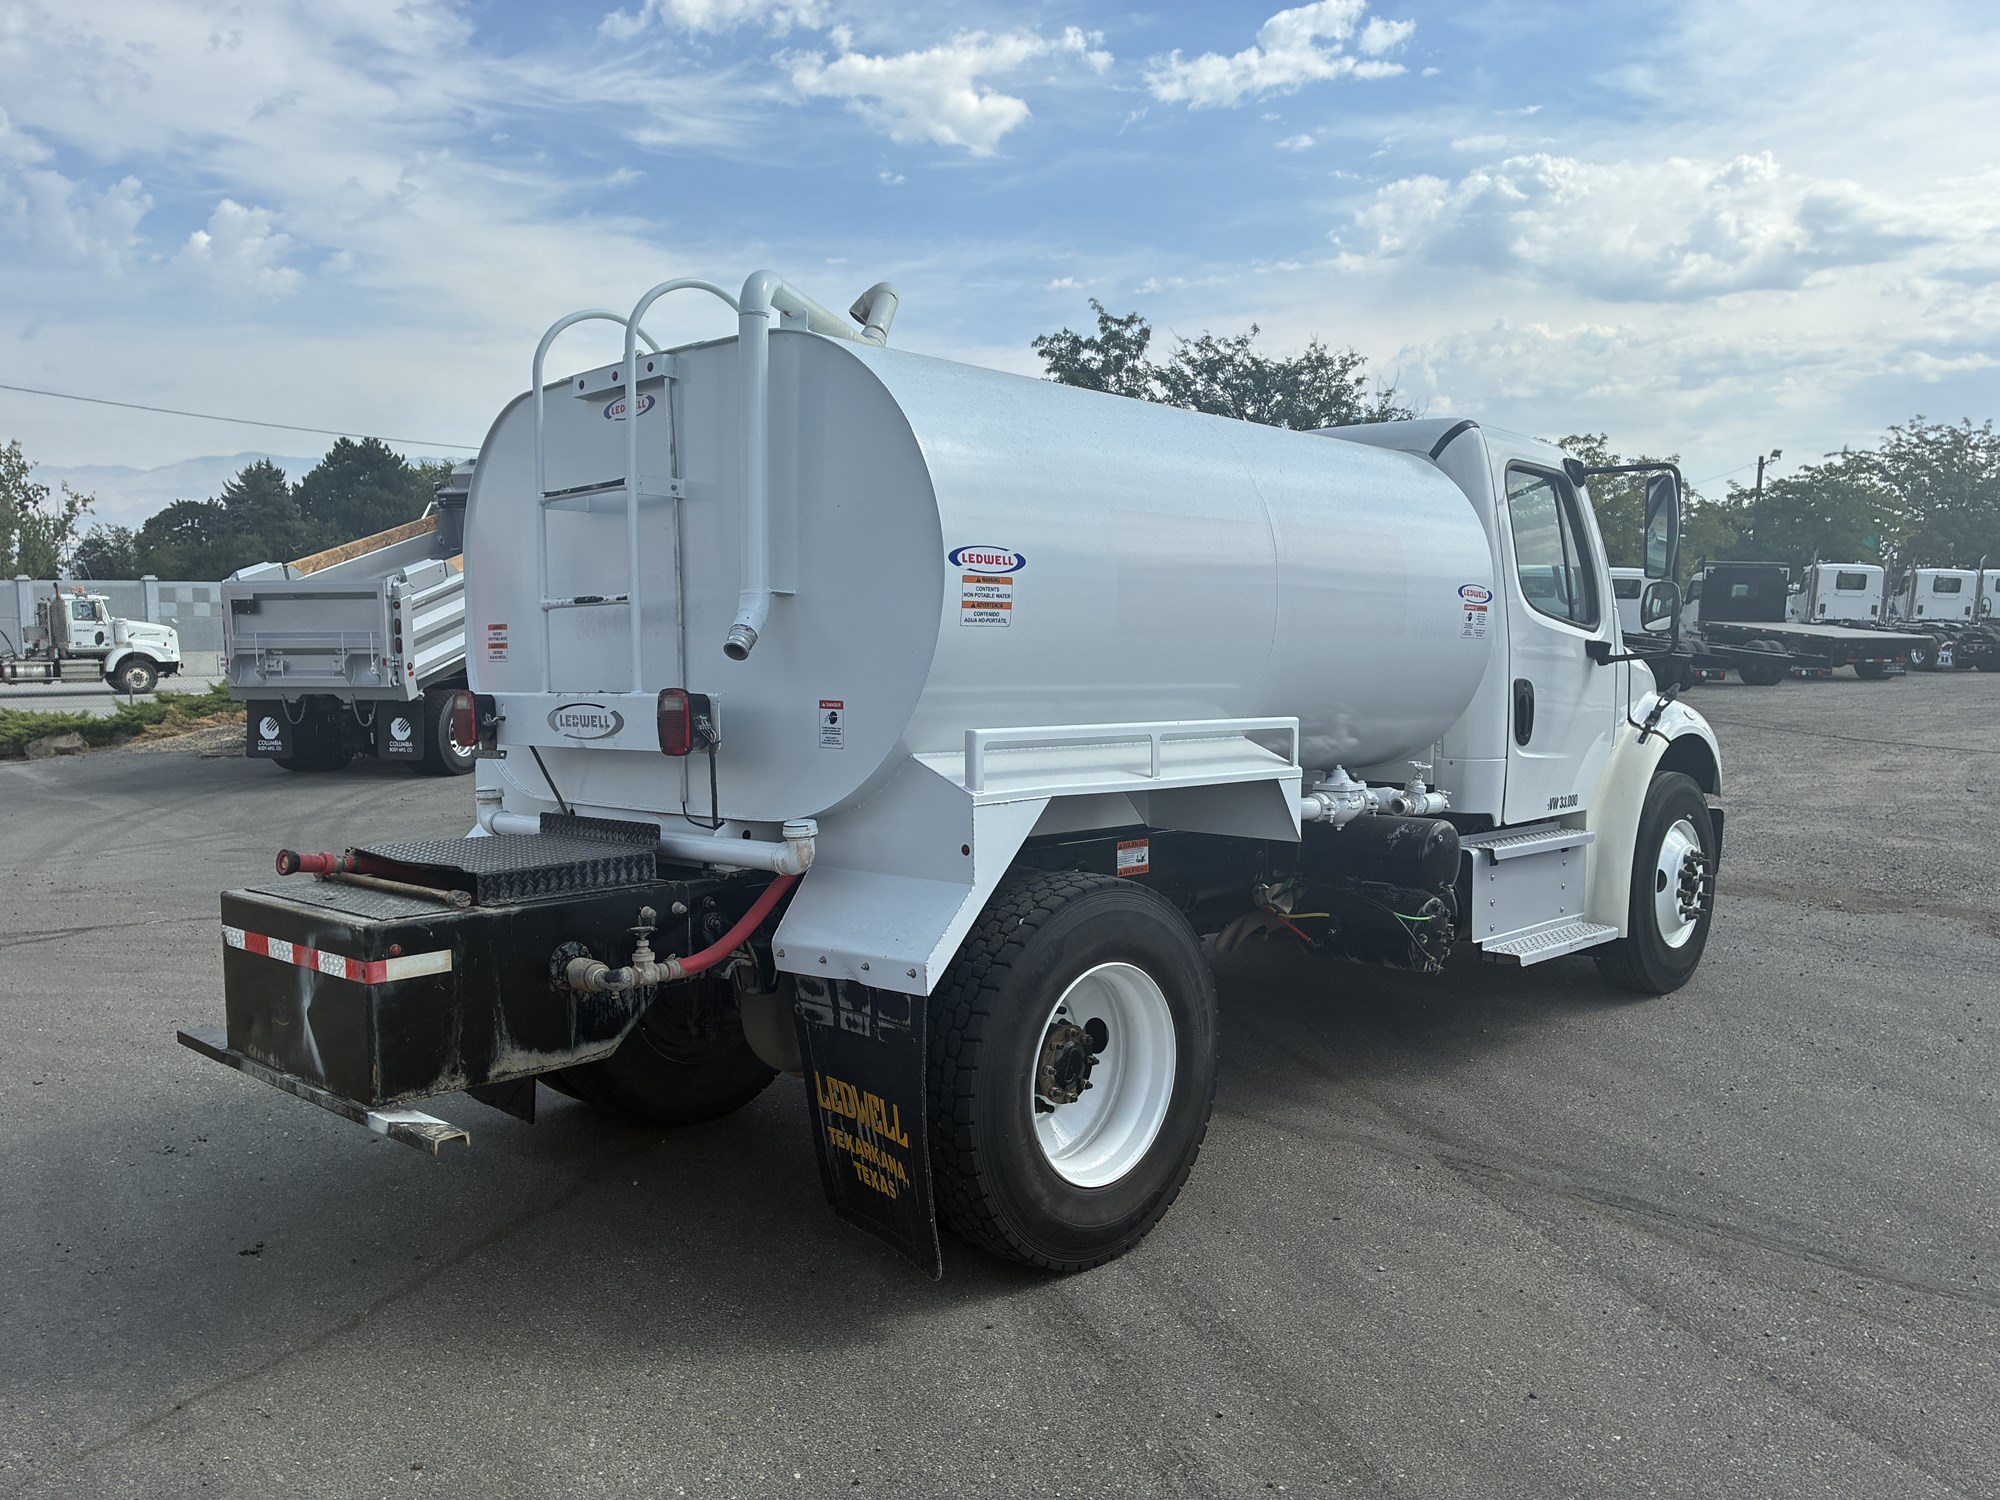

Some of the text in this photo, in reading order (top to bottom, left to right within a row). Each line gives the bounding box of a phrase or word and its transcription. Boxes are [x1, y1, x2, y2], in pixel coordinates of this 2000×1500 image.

[961, 553, 1014, 566] LEDWELL
[1463, 589, 1487, 599] LEDWELL
[560, 714, 610, 729] LEDWELL
[1560, 793, 1578, 809] 33,000
[1122, 839, 1148, 849] WARNING
[1122, 865, 1148, 876] WARNING
[815, 1071, 909, 1149] LEDWELL
[827, 1125, 910, 1189] TEXARKANA,
[853, 1160, 897, 1200] TEXAS
